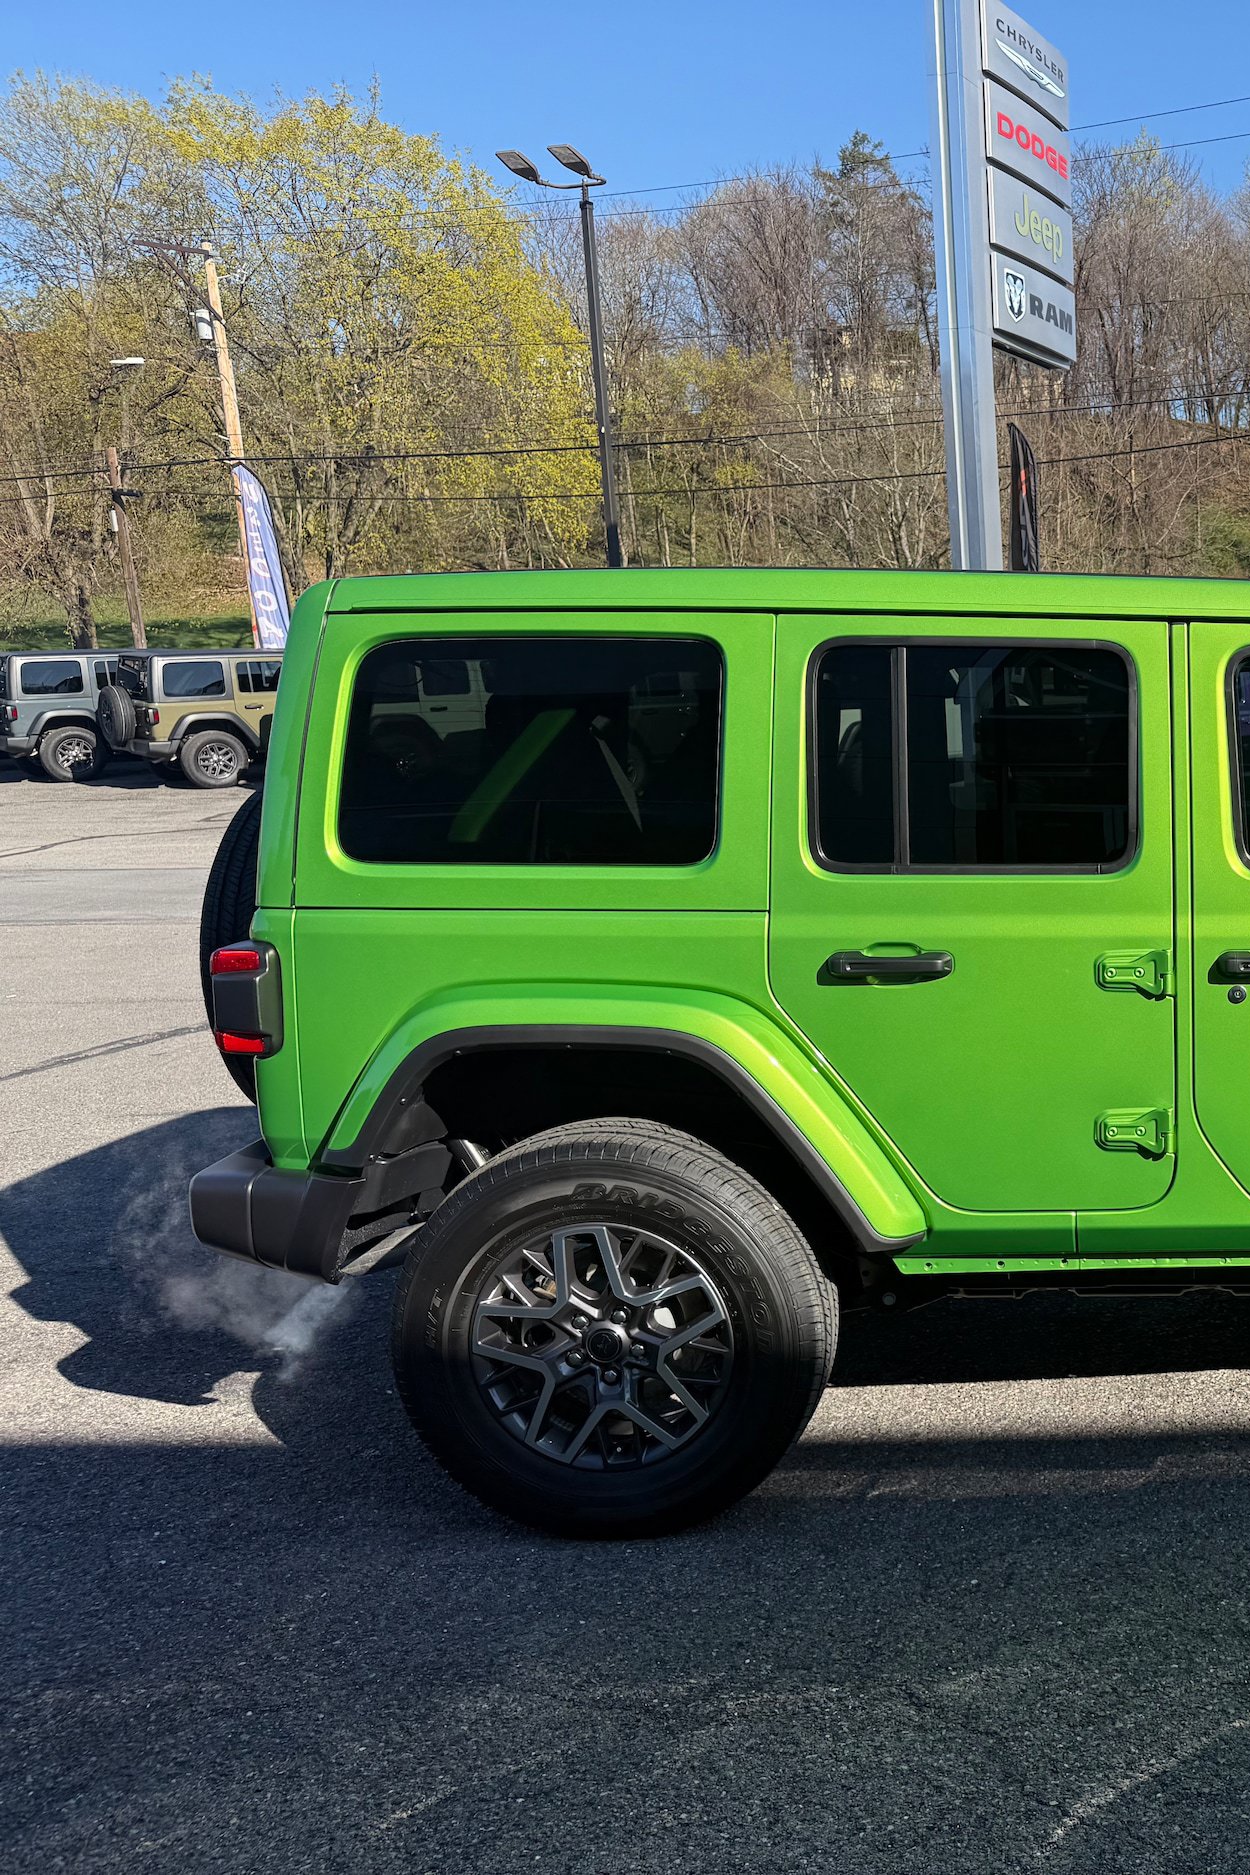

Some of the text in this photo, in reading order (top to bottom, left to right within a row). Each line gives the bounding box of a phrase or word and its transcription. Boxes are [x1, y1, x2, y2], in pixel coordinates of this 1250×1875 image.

[995, 17, 1065, 84] CHRYSLER
[996, 111, 1069, 181] DODGE
[1014, 193, 1063, 264] Jeep
[1029, 292, 1073, 336] RAM
[570, 1182, 777, 1355] BRIDGESTON
